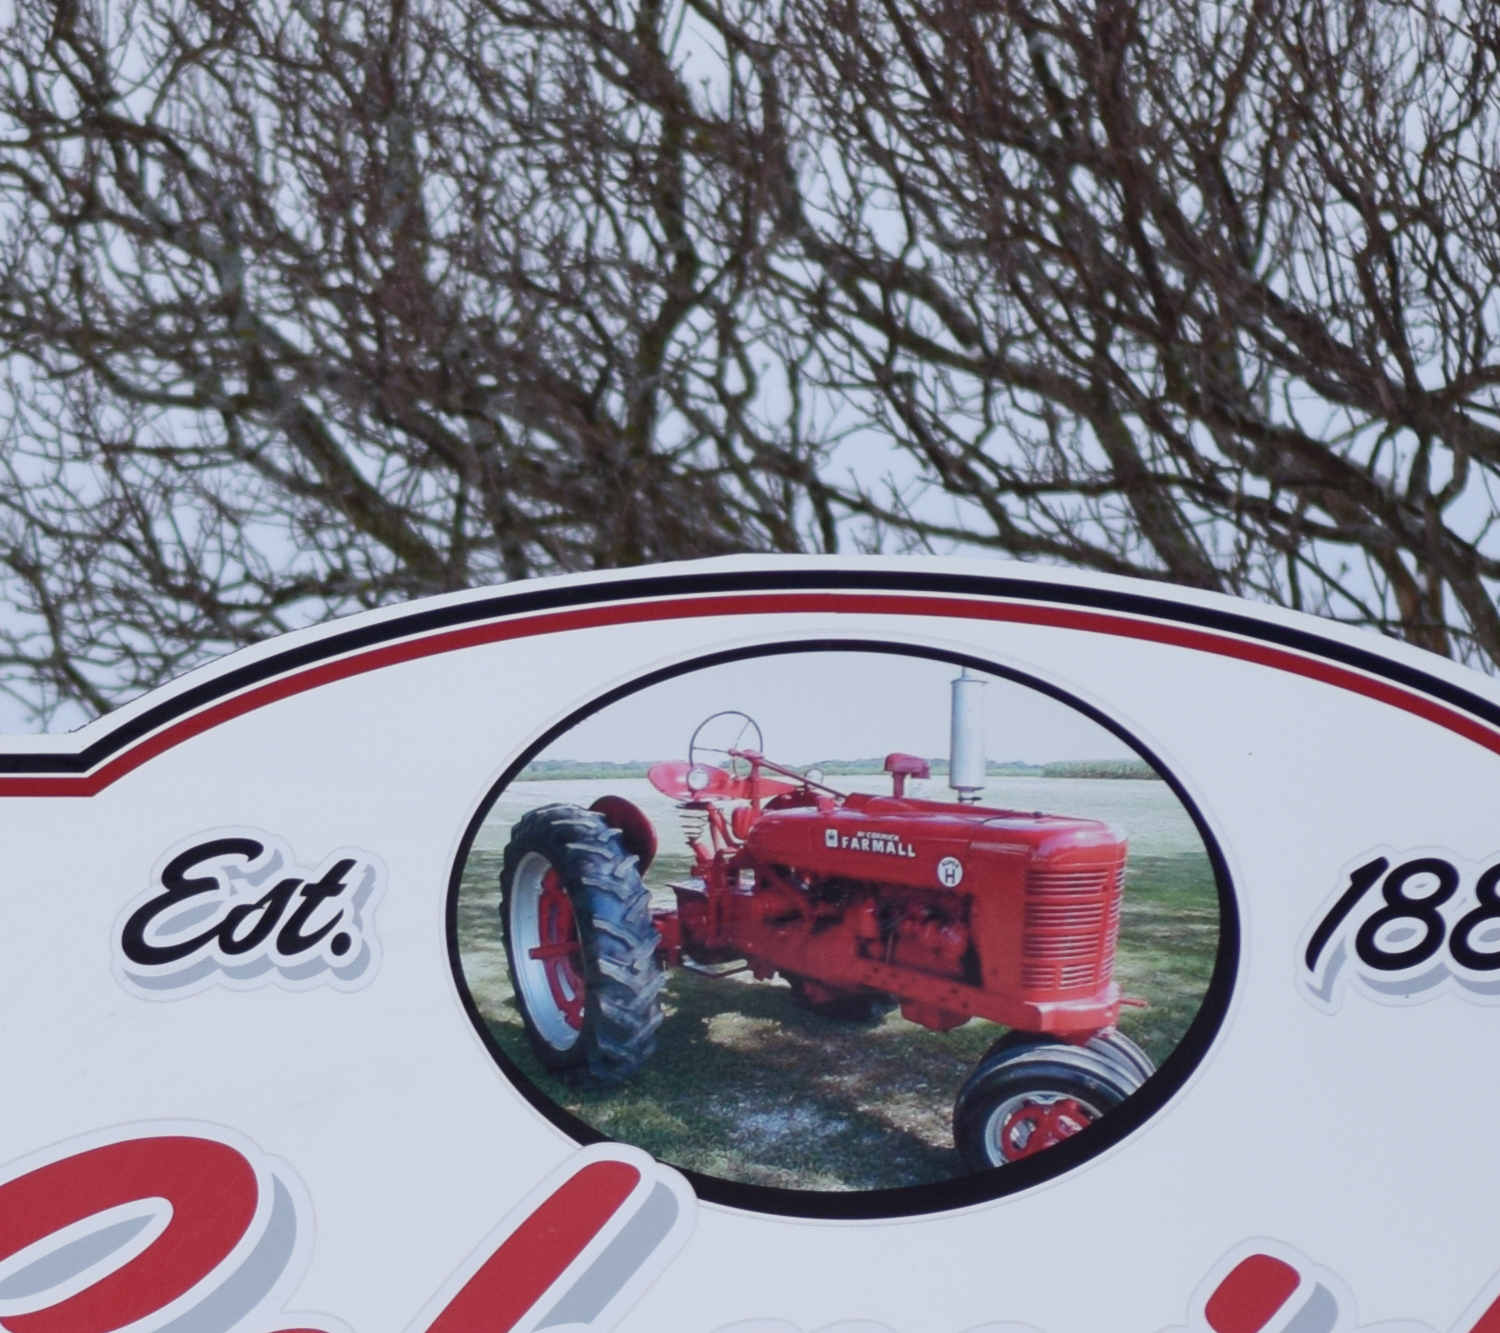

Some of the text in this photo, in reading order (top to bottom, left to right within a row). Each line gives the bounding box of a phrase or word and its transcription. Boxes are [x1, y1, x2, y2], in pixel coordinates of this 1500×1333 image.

[842, 836, 916, 858] FARMALL
[944, 867, 956, 885] H
[121, 838, 355, 966] Est.
